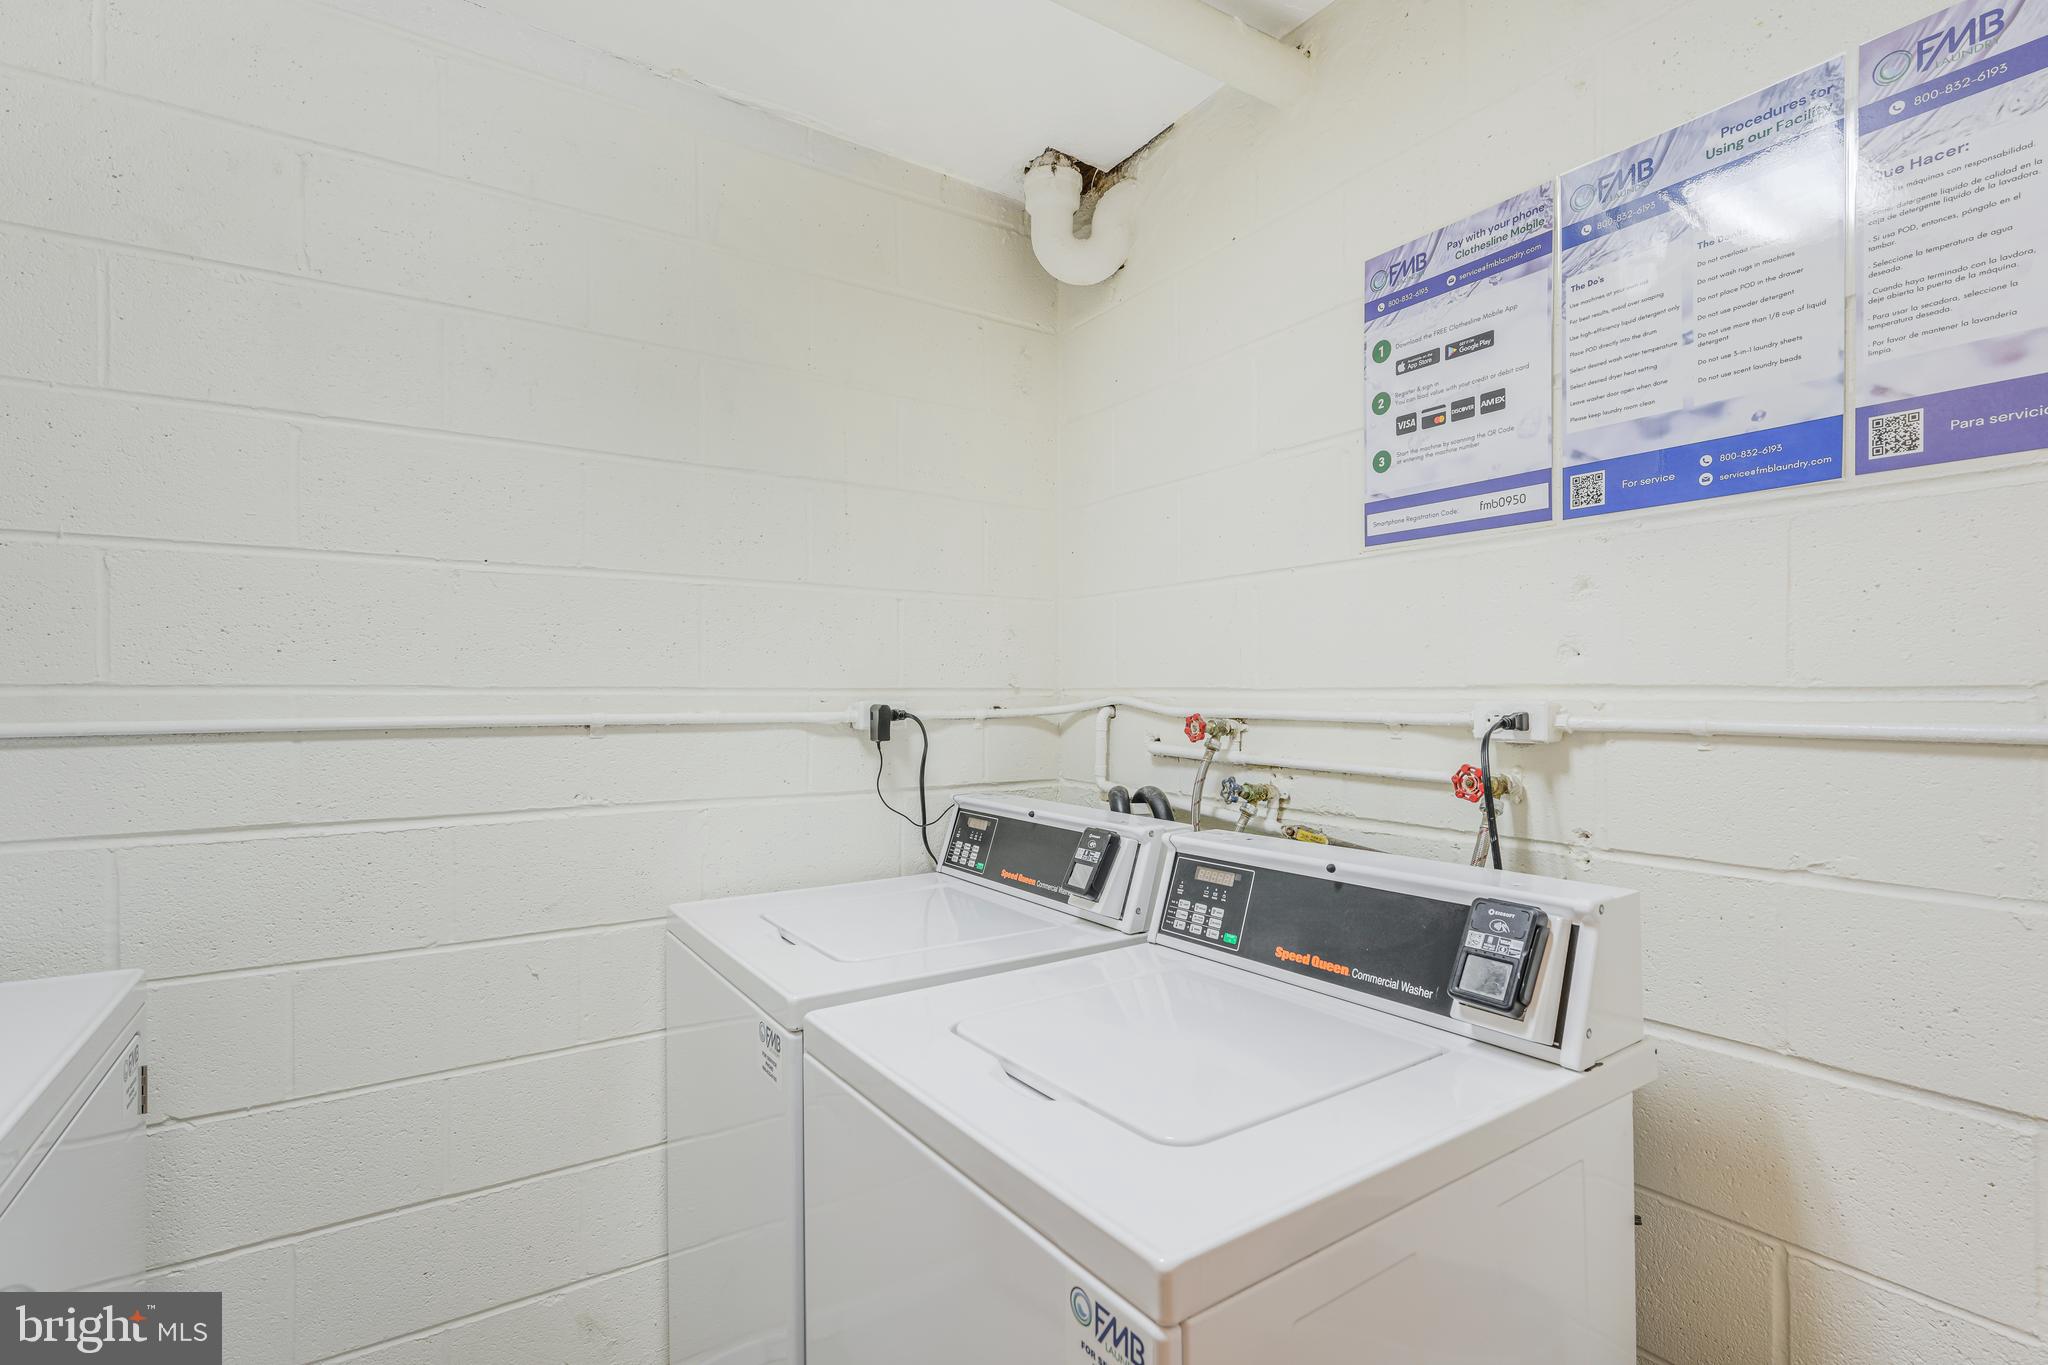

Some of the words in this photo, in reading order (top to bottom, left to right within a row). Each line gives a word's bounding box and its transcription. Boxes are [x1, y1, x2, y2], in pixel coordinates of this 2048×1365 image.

[1916, 8, 2005, 72] FMB
[1935, 37, 2000, 68] LAUNDRY
[1914, 62, 2008, 106] 800-832-6193
[1720, 94, 1806, 138] Procedures
[1706, 136, 1744, 160] Using
[1748, 126, 1773, 144] our
[1910, 142, 1970, 170] Hacer:
[1947, 166, 1962, 174] con
[1964, 140, 2036, 168] responsabilidad.
[1598, 158, 1654, 204] FMB
[1971, 177, 1982, 186] de
[1984, 168, 2018, 182] calidad
[1900, 200, 1941, 218] detergente
[1974, 185, 1985, 194] de
[1447, 238, 1464, 250] Pay
[1466, 228, 1486, 244] with
[1488, 219, 1510, 236] your
[1512, 204, 1545, 226] phone
[1898, 224, 1918, 235] POD,
[1921, 212, 1959, 228] entonces,
[1455, 233, 1508, 260] Clothesline
[1510, 218, 1544, 238] Mobile
[1872, 252, 1913, 270] Seleccione
[1926, 236, 1974, 253] temperatura
[1977, 232, 1988, 240] de
[1990, 225, 2014, 237] agua
[1389, 252, 1428, 287] FMB
[1459, 244, 1542, 281] service@fmblaundry.com
[1697, 260, 1706, 268] Do
[1708, 274, 1718, 282] not
[1720, 268, 1736, 278] wash
[1738, 265, 1752, 274] rugs
[1762, 251, 1796, 265] machines
[1570, 283, 1586, 292] The
[1588, 276, 1604, 287] Do's
[1697, 296, 1706, 304] Do
[1720, 288, 1738, 298] place
[1740, 281, 1756, 291] POD
[1778, 268, 1804, 280] drawer
[1868, 295, 1885, 306] deje
[1886, 288, 1914, 300] abierta
[1954, 274, 1966, 282] de
[1872, 283, 1902, 295] Cuando
[1905, 276, 1925, 288] haya
[1927, 265, 1968, 280] terminado
[1970, 261, 1986, 270] con
[1628, 300, 1640, 308] over
[1638, 308, 1666, 322] detergent
[1668, 304, 1680, 314] only
[1708, 310, 1718, 318] not
[1732, 300, 1758, 312] powder
[1760, 290, 1795, 304] detergent
[1733, 320, 1750, 329] more
[1752, 316, 1767, 324] than
[1782, 308, 1795, 318] cup
[1806, 298, 1827, 310] liquid
[1872, 312, 1890, 321] Para
[1892, 308, 1908, 316] usar
[1920, 294, 1960, 310] secadora,
[1964, 284, 2007, 299] seleccione
[2010, 280, 2018, 288] la
[1396, 334, 1423, 350] Download
[1434, 326, 1448, 338] FREE
[1449, 316, 1482, 332] Clothesline
[1482, 308, 1504, 320] Mobile
[1504, 304, 1518, 316] App
[1868, 314, 1914, 331] temperatura
[1916, 306, 1952, 320] deseada.
[1458, 342, 1478, 354] Google
[1480, 338, 1492, 350] Play
[1570, 350, 1584, 358] Place
[1585, 346, 1598, 354] POD
[1642, 330, 1658, 338] drum
[1697, 336, 1729, 348] detergent
[1720, 352, 1732, 360] use
[1754, 341, 1778, 353] laundry
[1780, 336, 1802, 346] sheets
[1872, 340, 1884, 348] Por
[1887, 334, 1906, 344] favor
[1908, 331, 1919, 340] de
[1921, 323, 1958, 336] mantener
[1378, 346, 1385, 358] 1
[1407, 362, 1418, 371] App
[1419, 357, 1432, 366] Store
[1570, 366, 1586, 374] Select
[1624, 352, 1640, 360] water
[1642, 341, 1678, 357] temperature
[1734, 366, 1751, 375] scent
[1752, 360, 1778, 372] laundry
[1780, 354, 1802, 364] beads
[1570, 382, 1586, 390] Select
[1638, 364, 1658, 374] setting
[1378, 398, 1385, 409] 2
[1480, 396, 1506, 408] AMEX
[1586, 394, 1605, 403] washer
[1606, 390, 1619, 398] door
[1620, 388, 1636, 396] open
[1636, 382, 1652, 390] when
[1652, 380, 1668, 388] done
[1451, 404, 1474, 416] DISCOVER
[1588, 412, 1602, 420] keep
[1602, 407, 1622, 418] laundry
[1640, 400, 1656, 408] clean
[1398, 418, 1416, 430] VISA
[1950, 418, 1984, 430] Para
[1378, 457, 1385, 468] 3
[1720, 444, 1783, 462] 800-832-6193
[1622, 479, 1638, 489] For
[1640, 473, 1676, 486] service
[1719, 455, 1832, 482] service@fmblaundry.com
[1479, 493, 1526, 511] fmb0950
[1406, 511, 1440, 524] Registration
[1000, 868, 1018, 881] Speed
[1018, 873, 1036, 886] Queen
[1036, 880, 1058, 893] Commercial
[1274, 946, 1310, 966] Speed
[1311, 956, 1350, 976] Queen
[1352, 968, 1399, 990] Commercial
[1400, 980, 1434, 999] Washer
[766, 1025, 780, 1053] FMB
[1095, 1300, 1145, 1365] FMB
